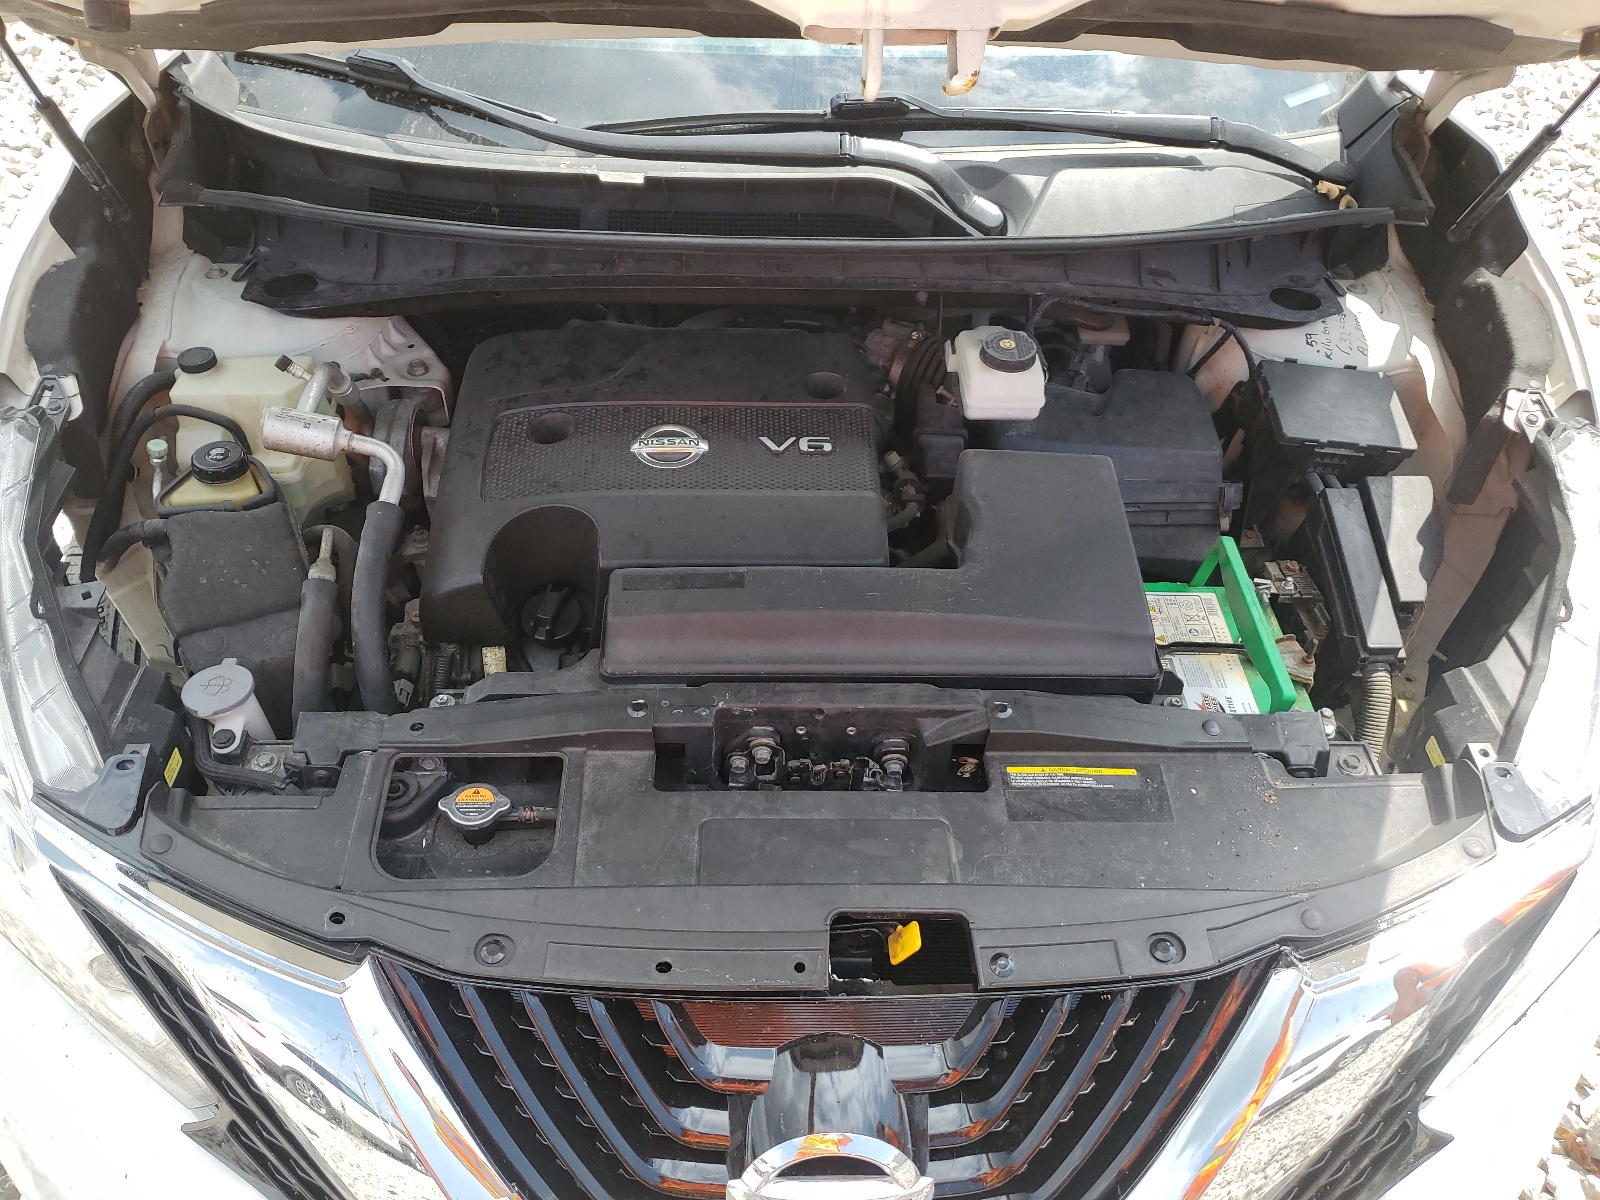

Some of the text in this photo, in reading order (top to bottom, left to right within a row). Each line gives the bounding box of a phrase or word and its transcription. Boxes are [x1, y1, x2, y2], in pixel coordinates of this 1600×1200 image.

[1305, 332, 1320, 353] .59
[638, 438, 700, 447] NISSAN
[758, 436, 833, 453] V6
